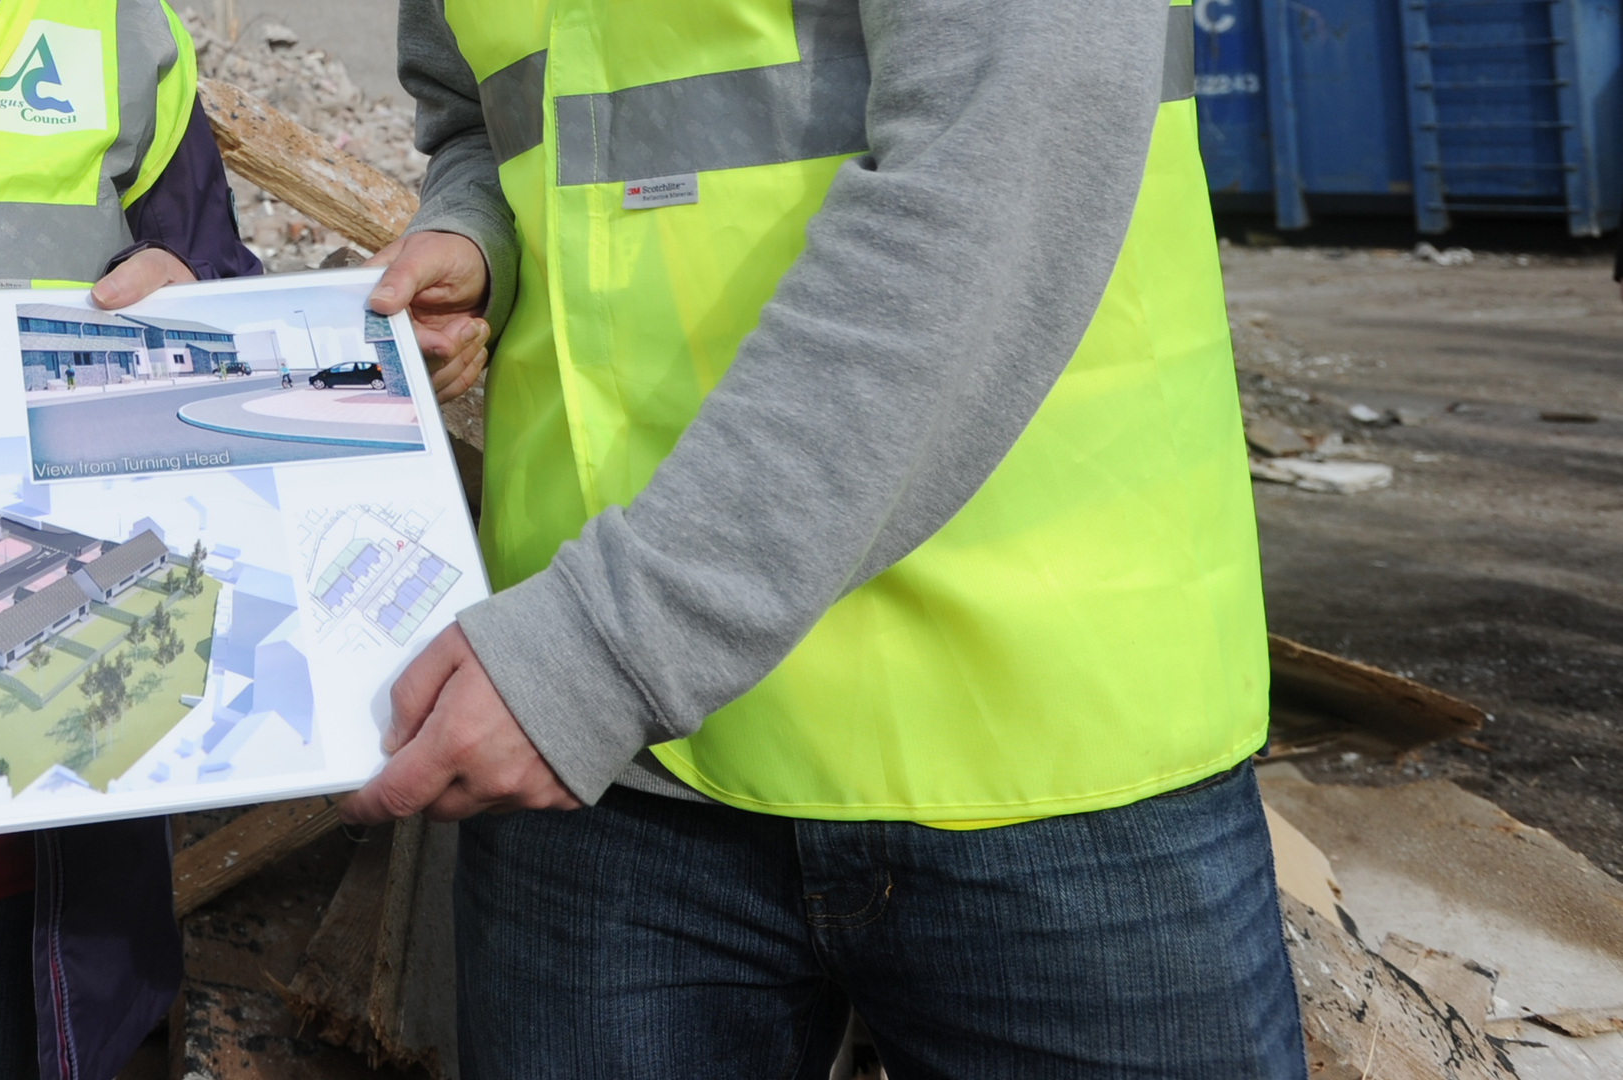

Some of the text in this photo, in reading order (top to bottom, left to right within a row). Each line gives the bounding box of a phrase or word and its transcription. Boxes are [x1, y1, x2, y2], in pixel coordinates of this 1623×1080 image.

[20, 107, 77, 125] Council
[627, 186, 641, 196] 3M
[670, 190, 694, 198] Material
[34, 450, 230, 478] View from Turning Head
